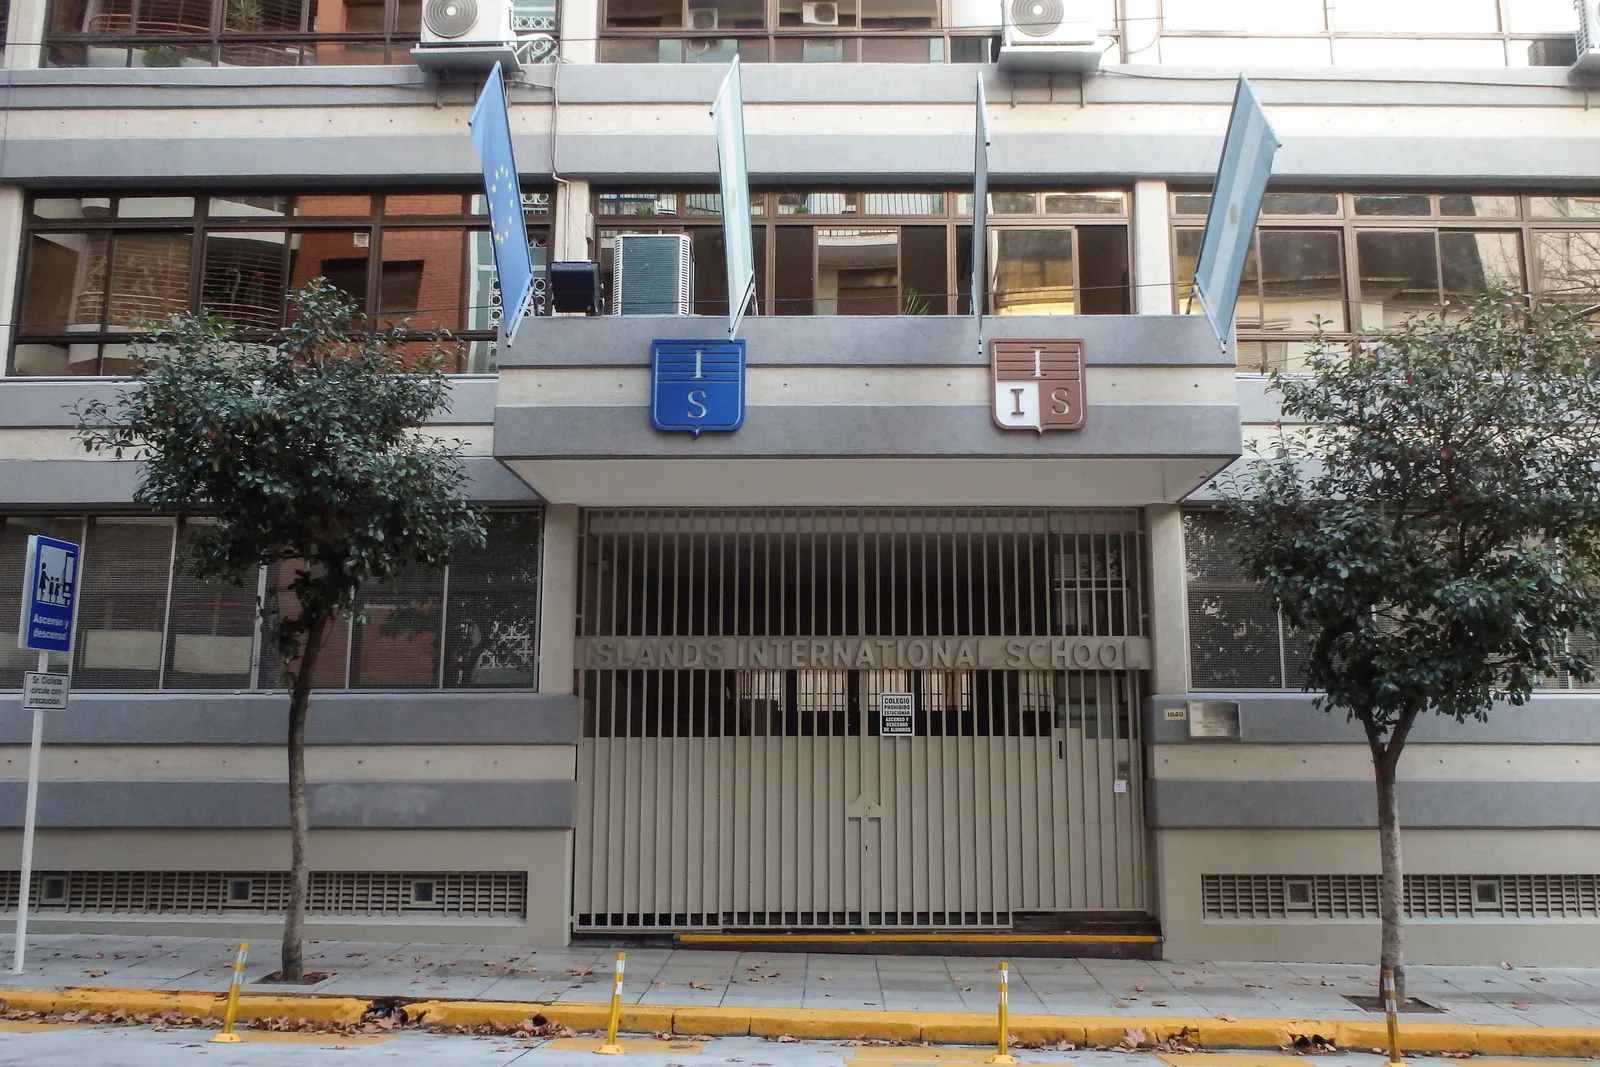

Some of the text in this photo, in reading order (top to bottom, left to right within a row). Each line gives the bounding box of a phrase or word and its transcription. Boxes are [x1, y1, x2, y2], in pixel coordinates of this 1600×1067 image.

[687, 388, 708, 419] S
[1051, 387, 1070, 415] S
[33, 613, 70, 629] Ascenso y
[33, 628, 66, 640] descenso
[584, 639, 1141, 669] ISLANDS INTERNATIONAL SCHOOL
